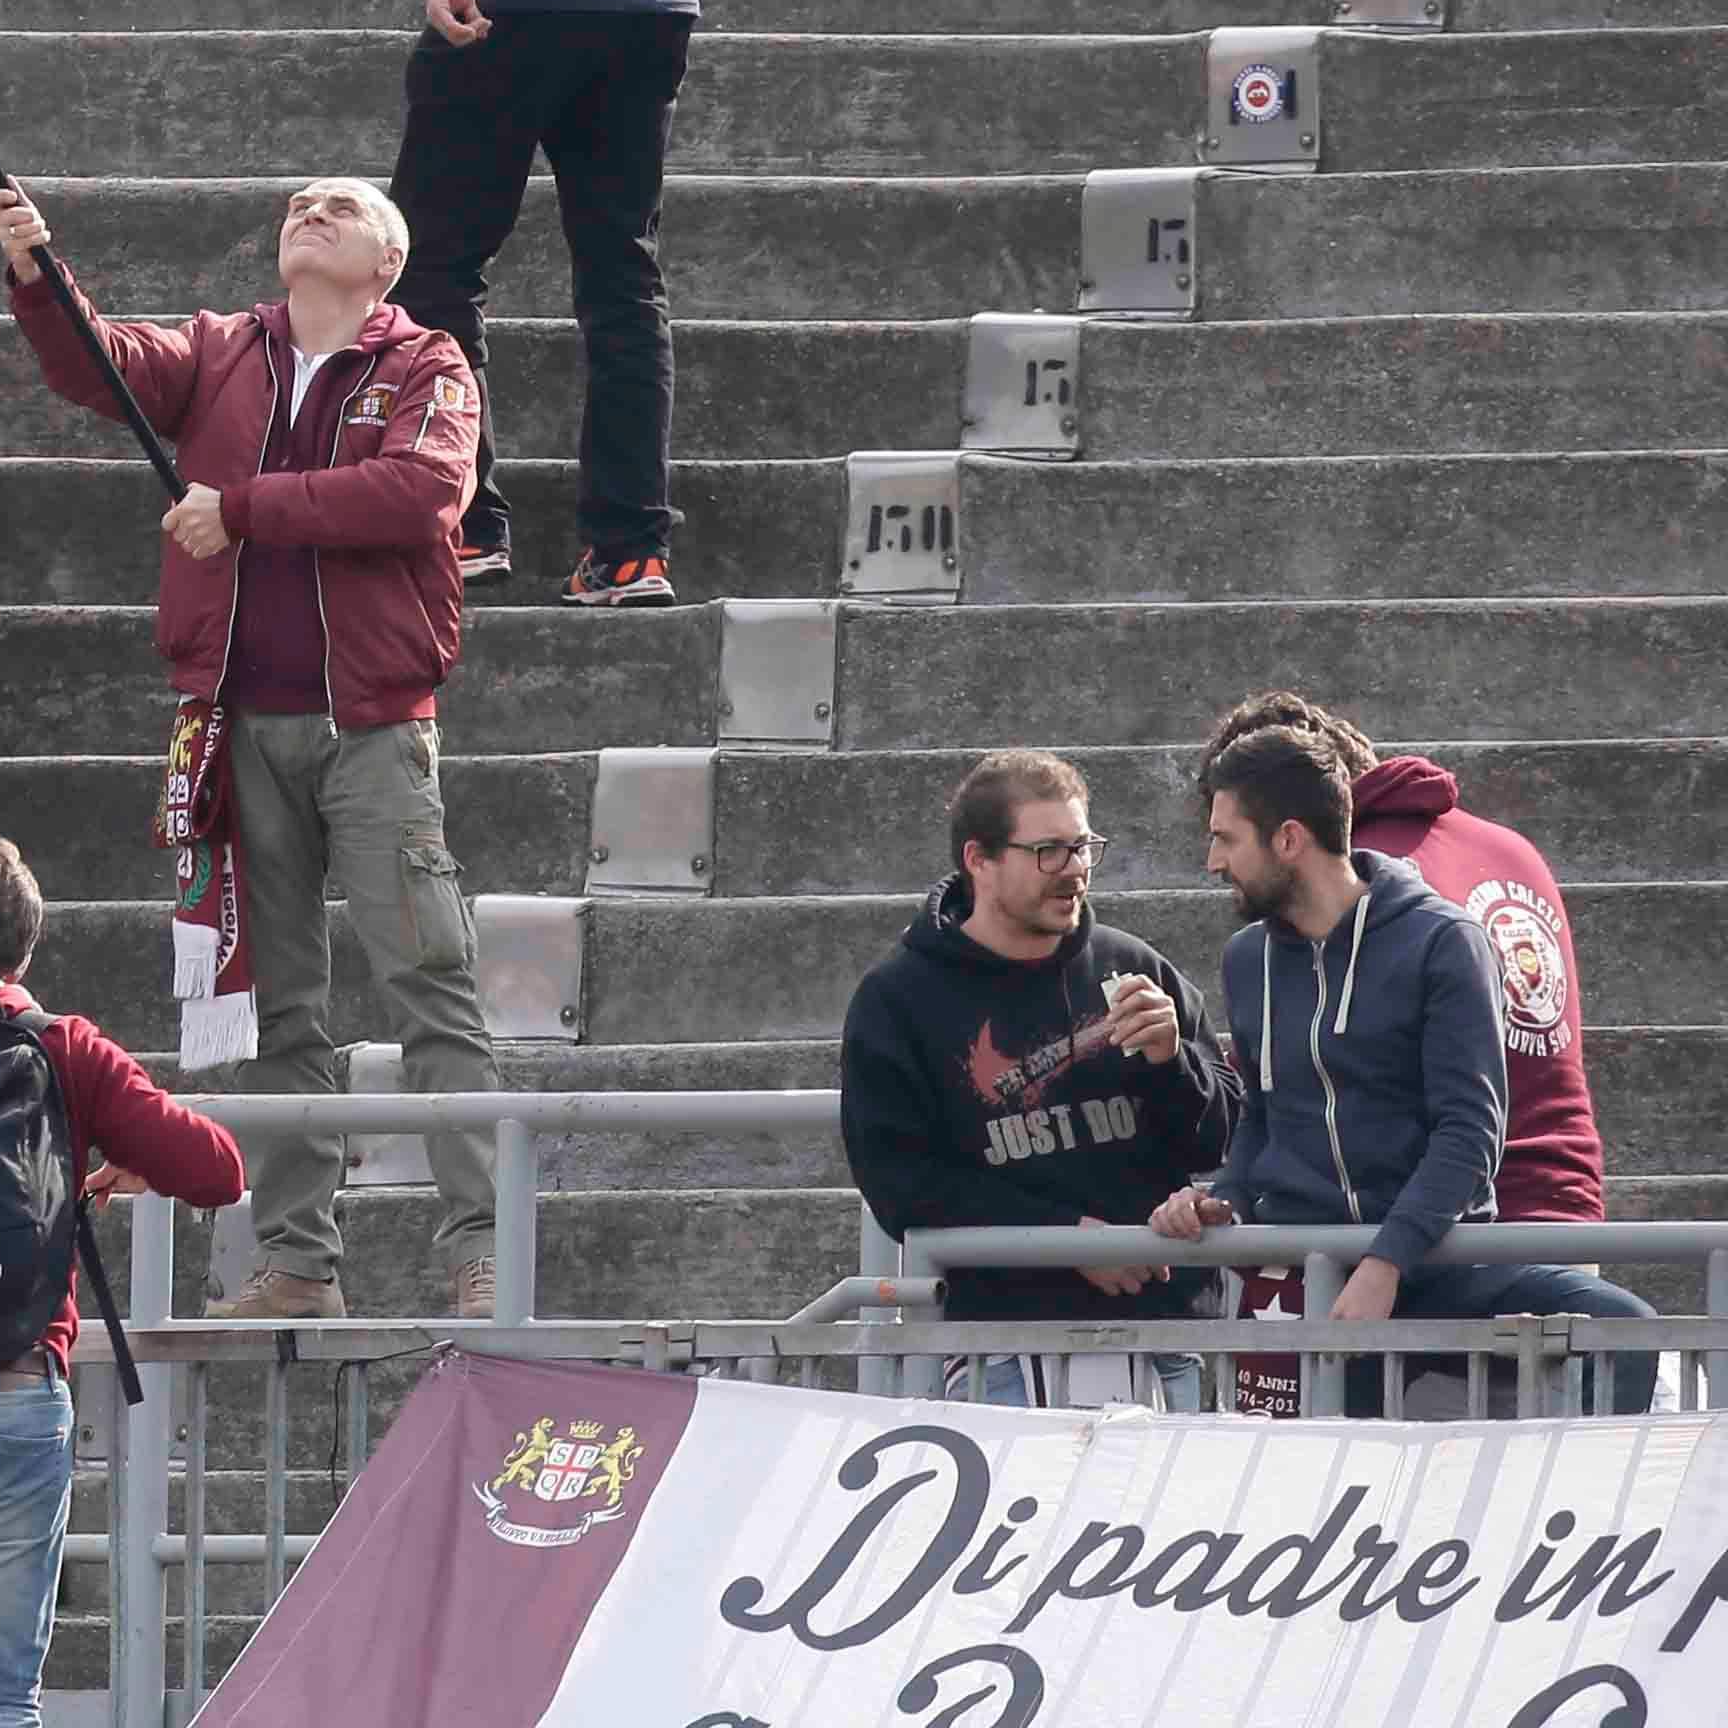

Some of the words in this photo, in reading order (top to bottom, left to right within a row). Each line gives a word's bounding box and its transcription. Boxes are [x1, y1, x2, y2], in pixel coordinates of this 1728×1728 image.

[983, 1103, 1077, 1166] JUST
[1079, 1095, 1138, 1144] DO
[1255, 1374, 1297, 1393] ANNI
[718, 1423, 1042, 1653] Di
[1002, 1483, 1482, 1635] padre
[1492, 1509, 1677, 1624] in
